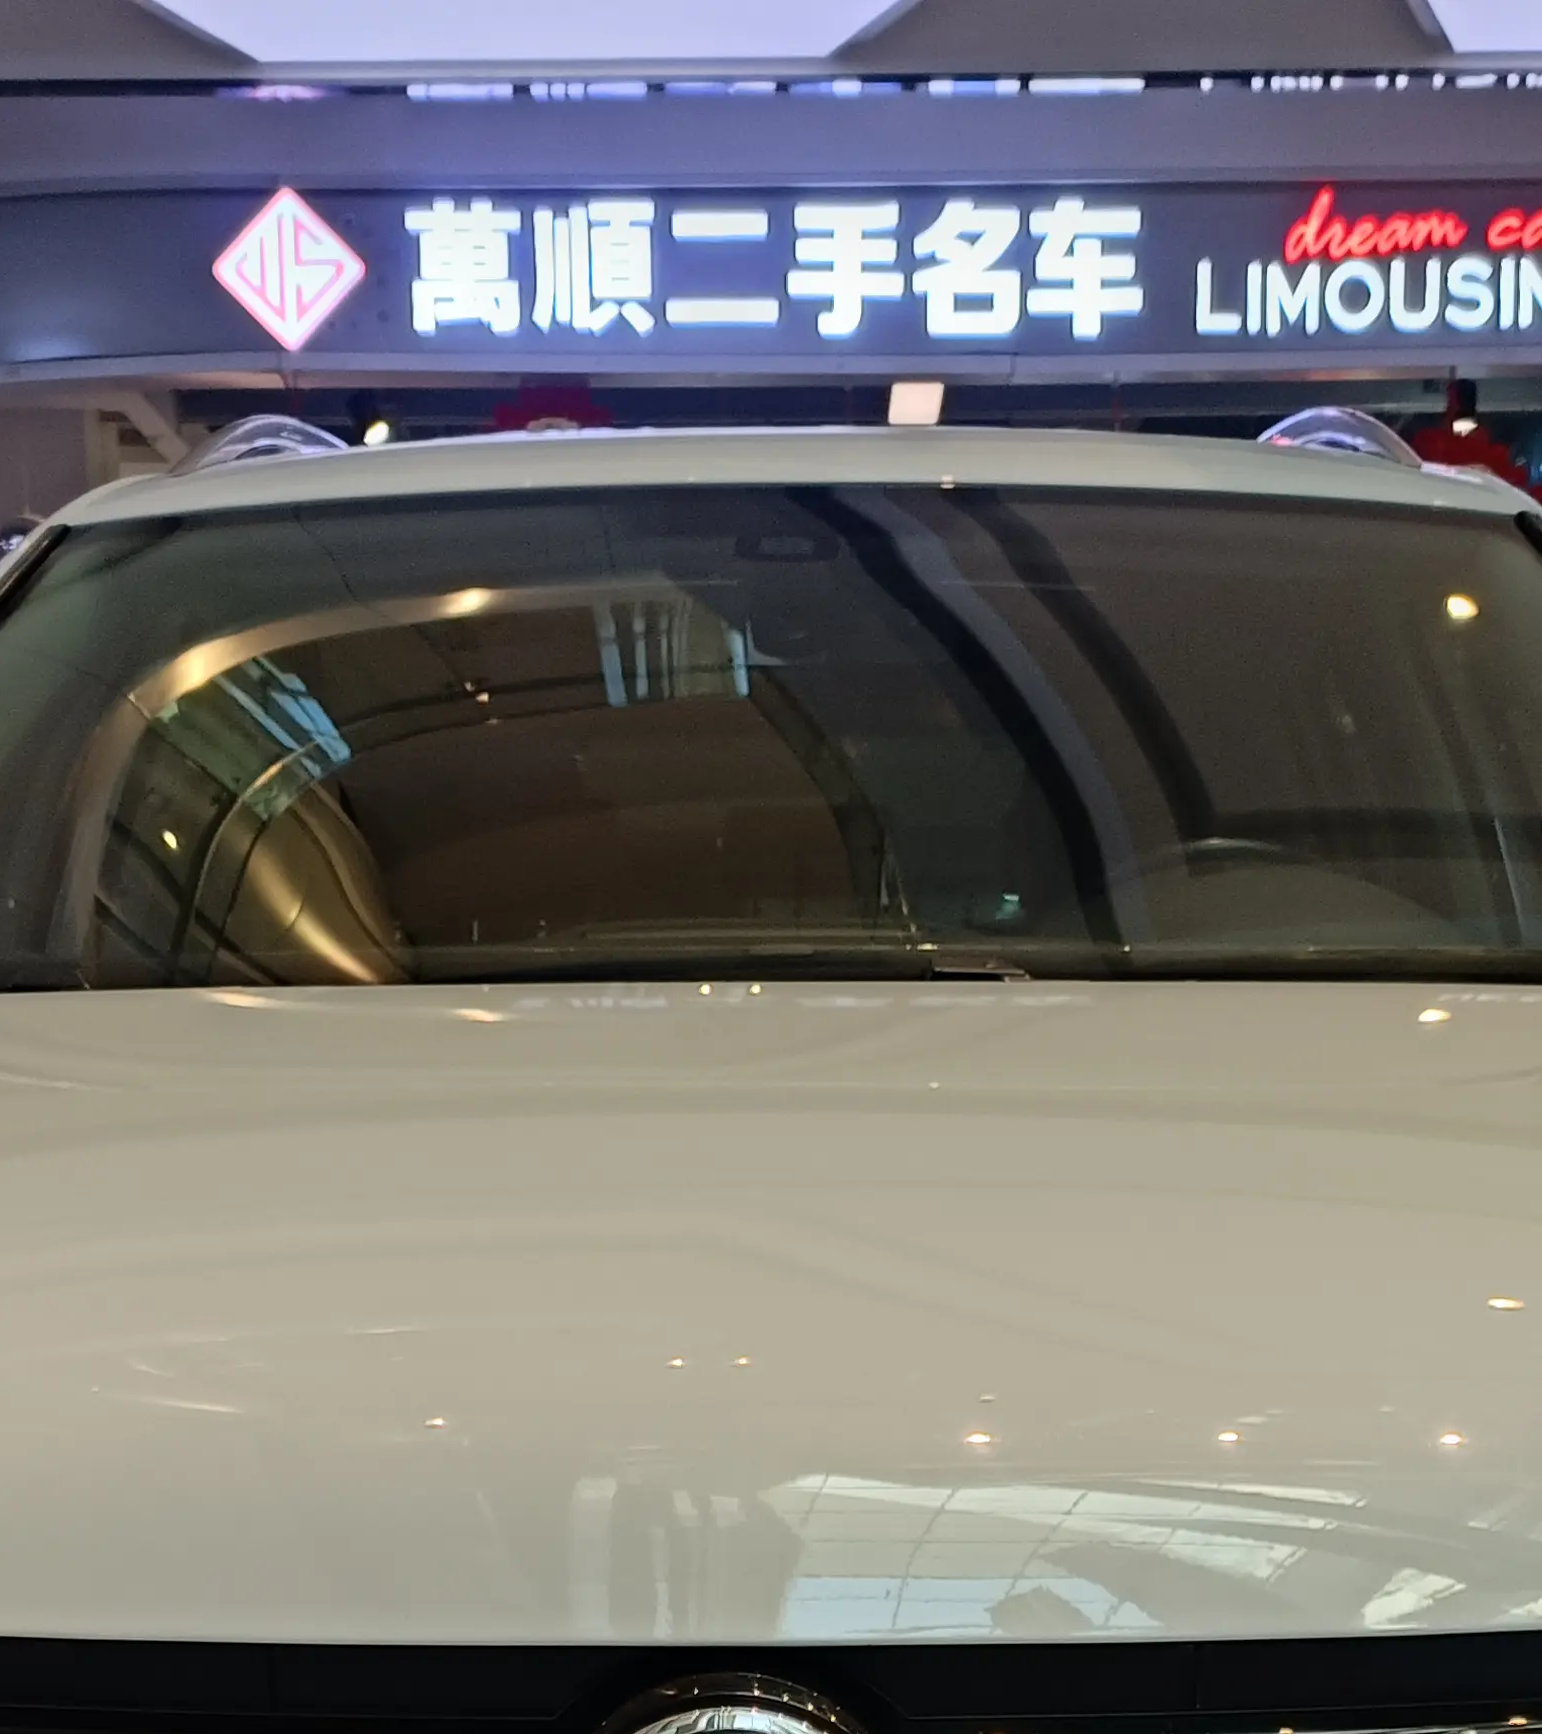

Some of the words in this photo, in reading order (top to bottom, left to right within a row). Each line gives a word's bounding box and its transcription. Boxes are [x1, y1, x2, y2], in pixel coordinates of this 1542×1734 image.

[404, 197, 1144, 339] 萬順二手名车
[1284, 183, 1468, 264] dream
